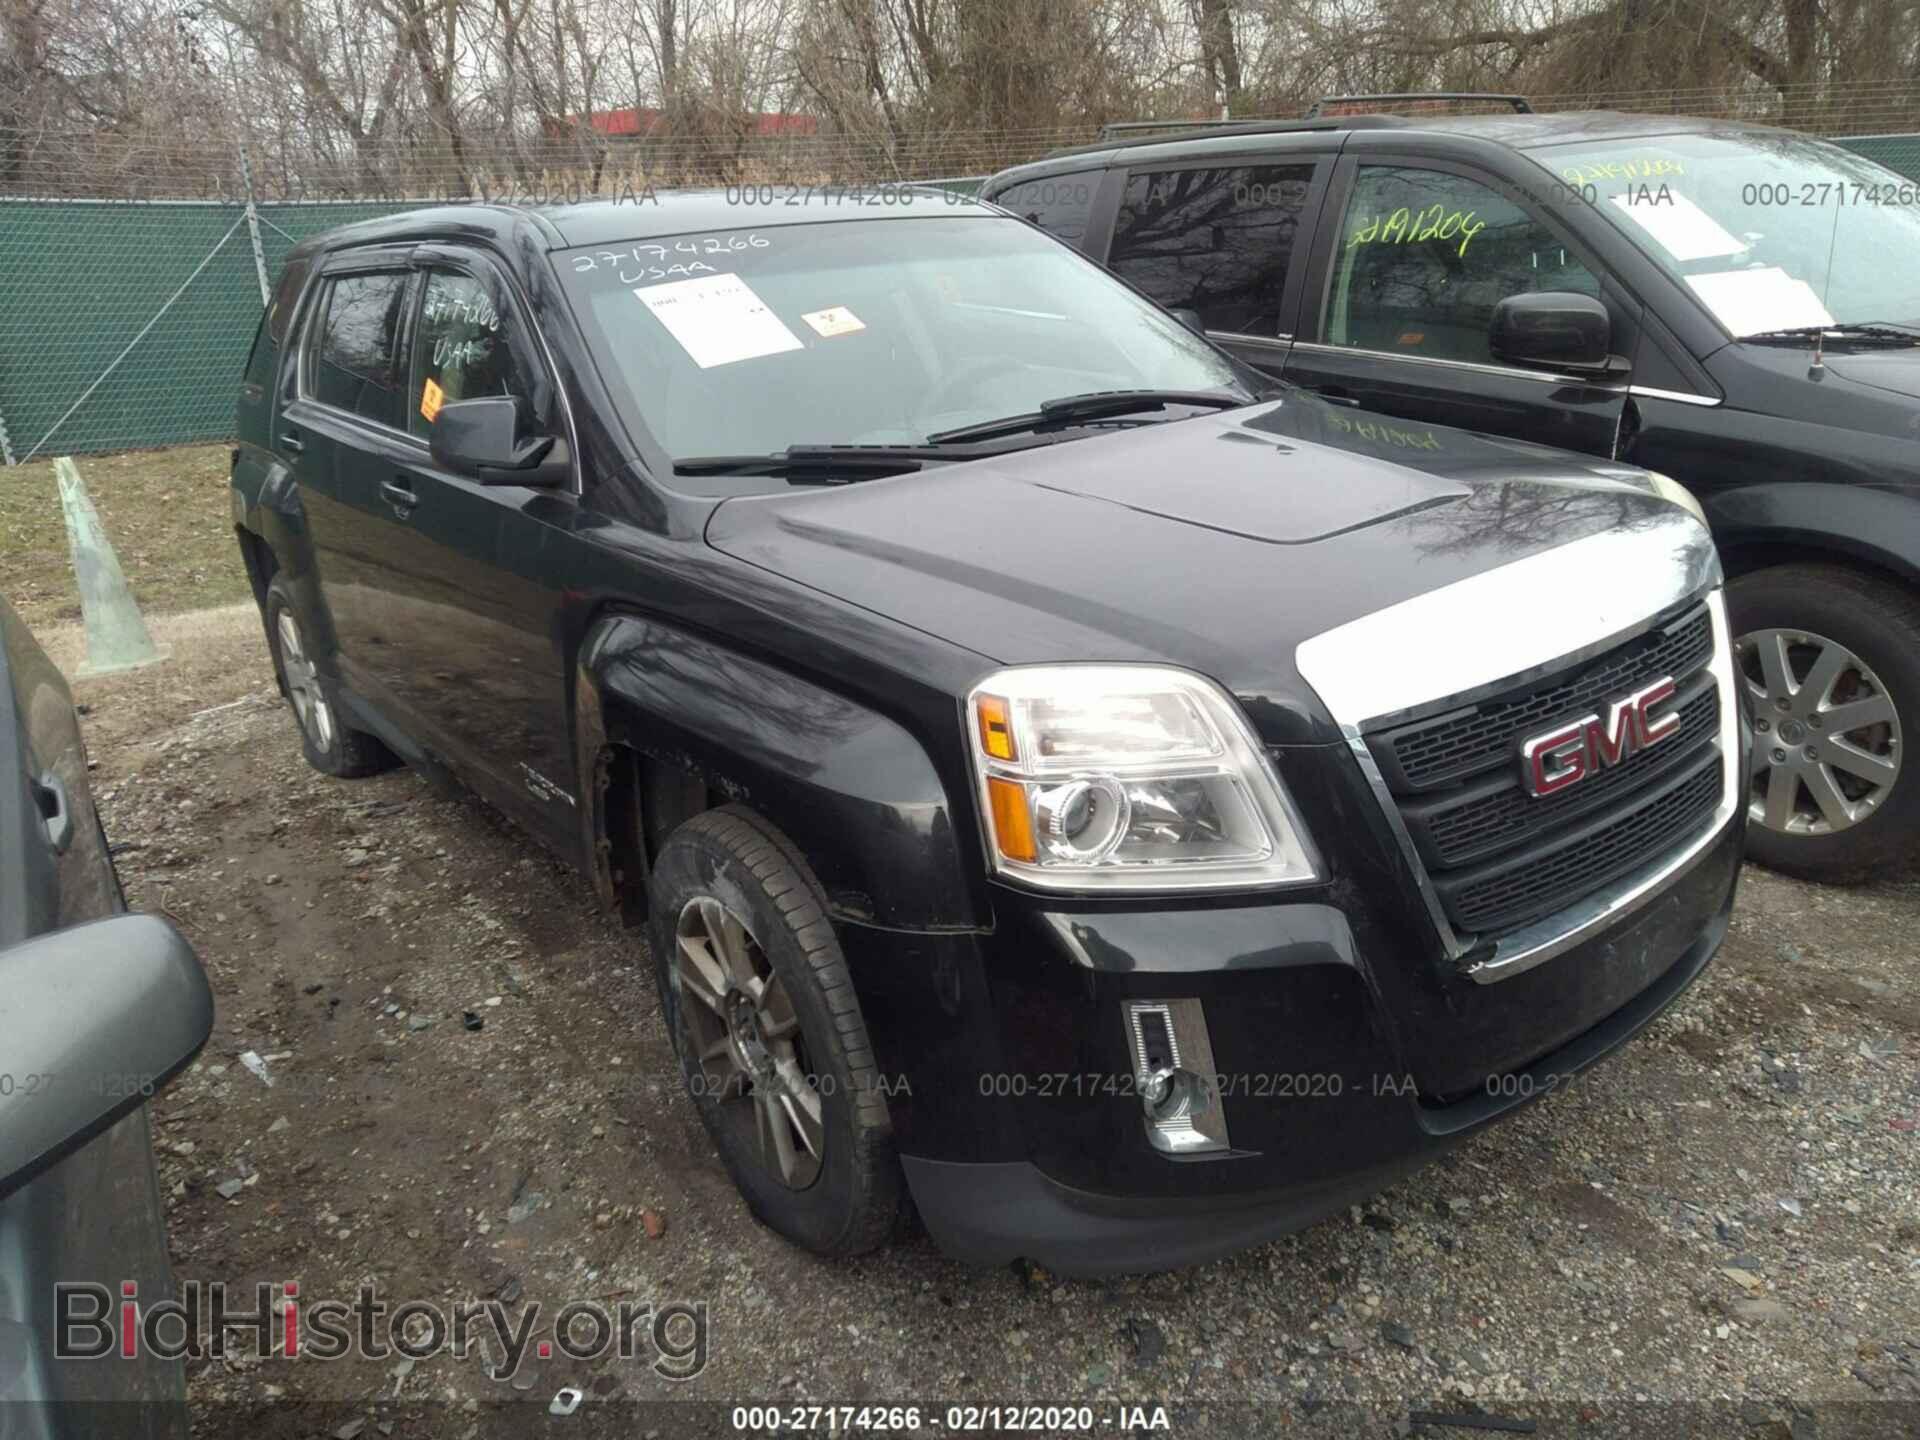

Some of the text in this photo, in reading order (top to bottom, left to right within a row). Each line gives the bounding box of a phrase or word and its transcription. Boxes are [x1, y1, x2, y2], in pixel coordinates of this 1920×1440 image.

[572, 234, 770, 272] 27174266
[620, 261, 717, 283] USAA
[1522, 676, 1680, 797] GMC
